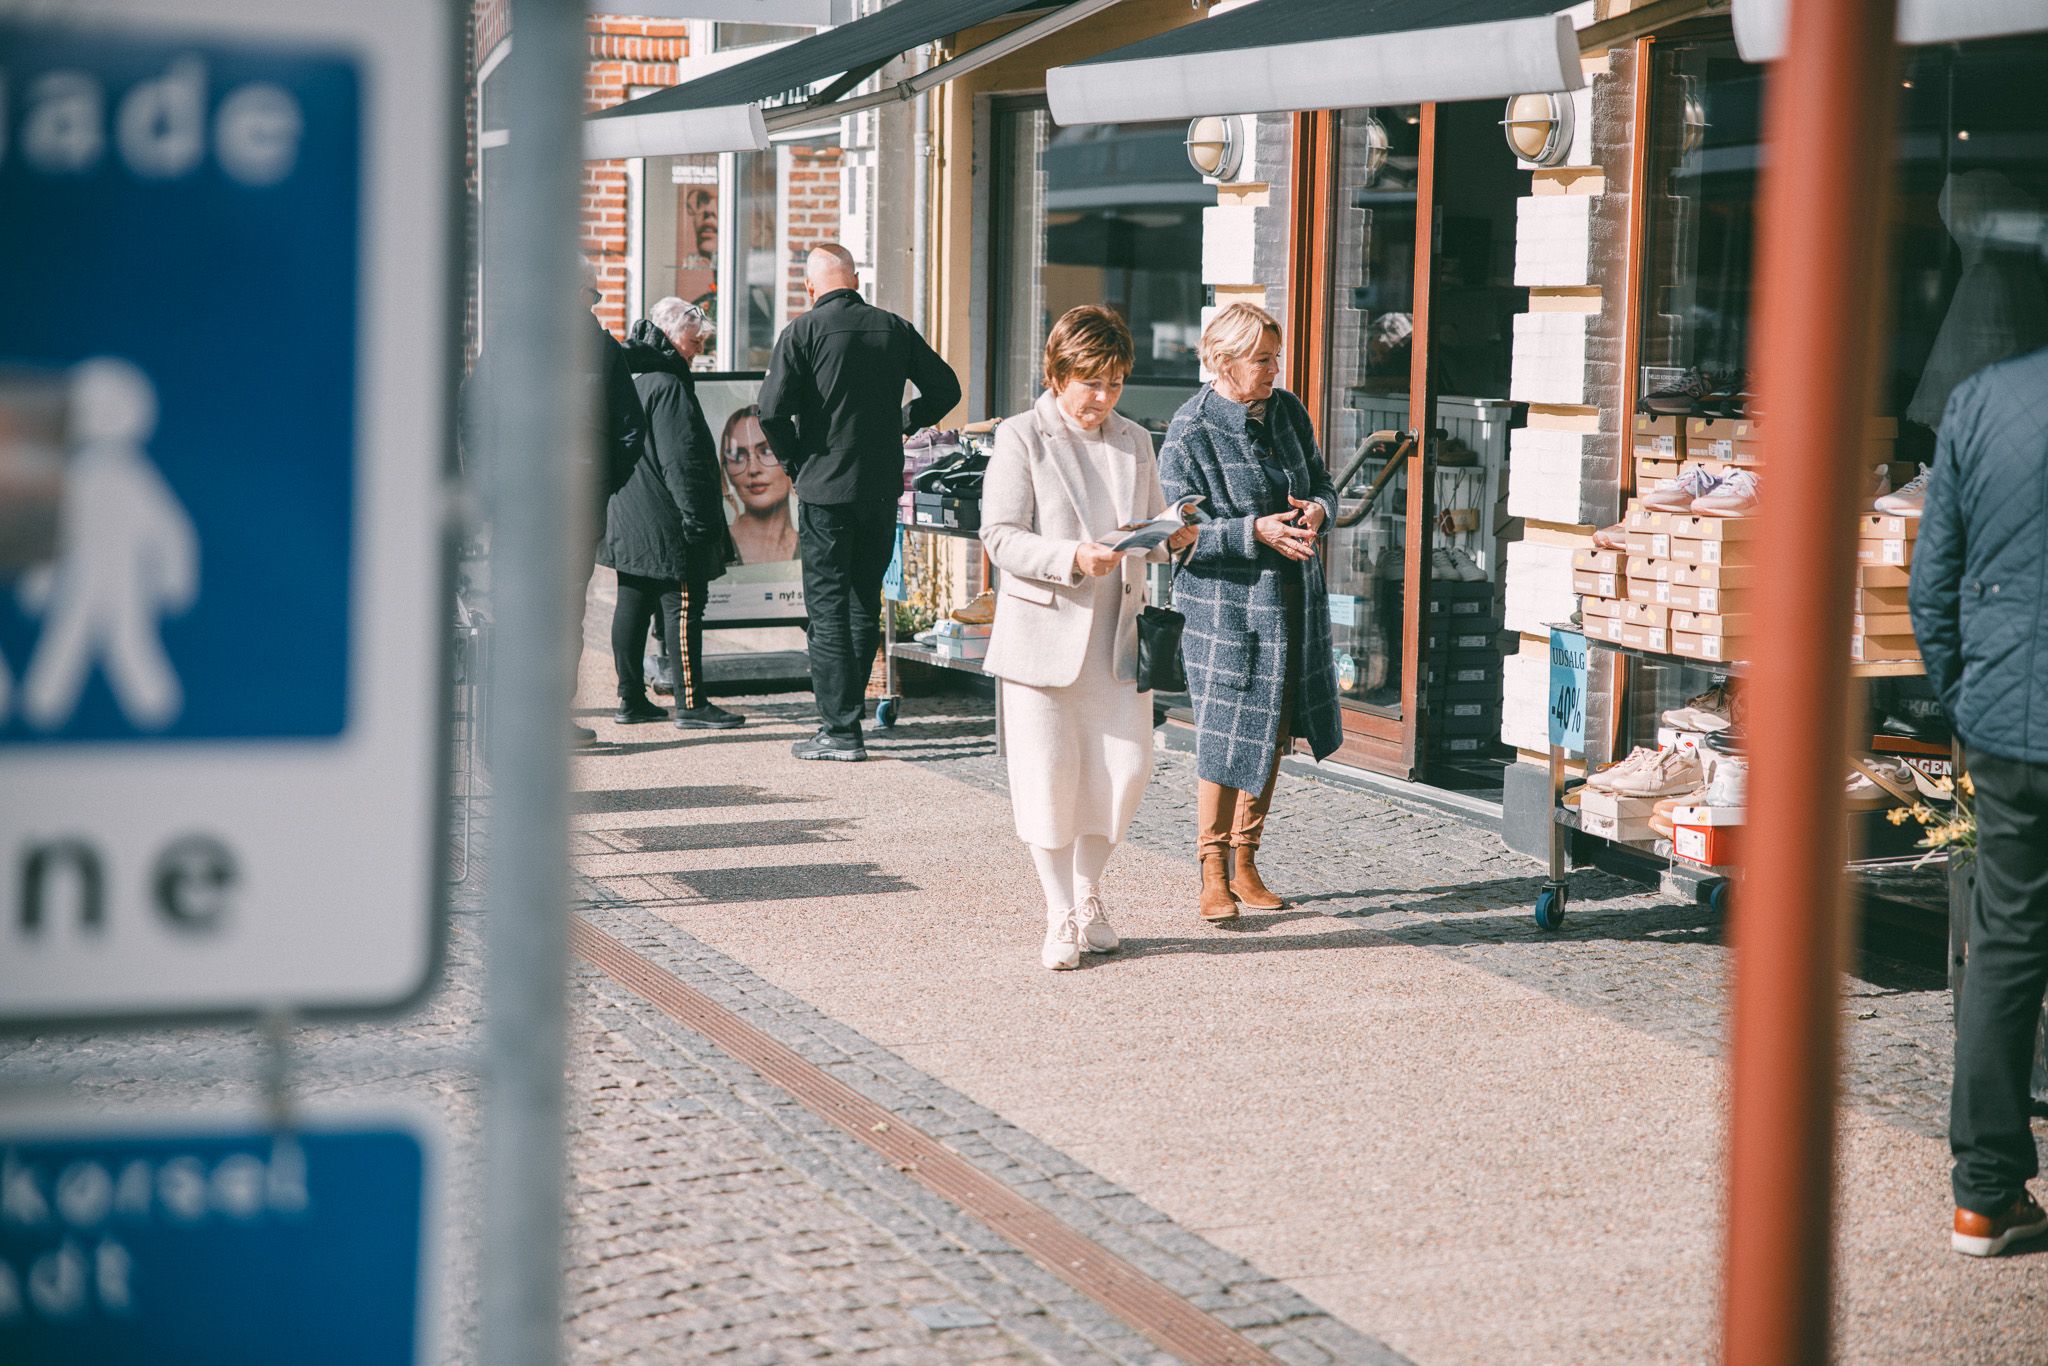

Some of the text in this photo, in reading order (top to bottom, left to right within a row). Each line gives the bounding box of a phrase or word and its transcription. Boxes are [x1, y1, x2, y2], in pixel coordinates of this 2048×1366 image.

[0, 50, 304, 184] ade
[779, 590, 795, 601] nyt
[1552, 647, 1585, 670] UDSALG
[1551, 685, 1581, 733] -40%
[1904, 757, 1953, 775] AGEN
[17, 825, 242, 938] ne
